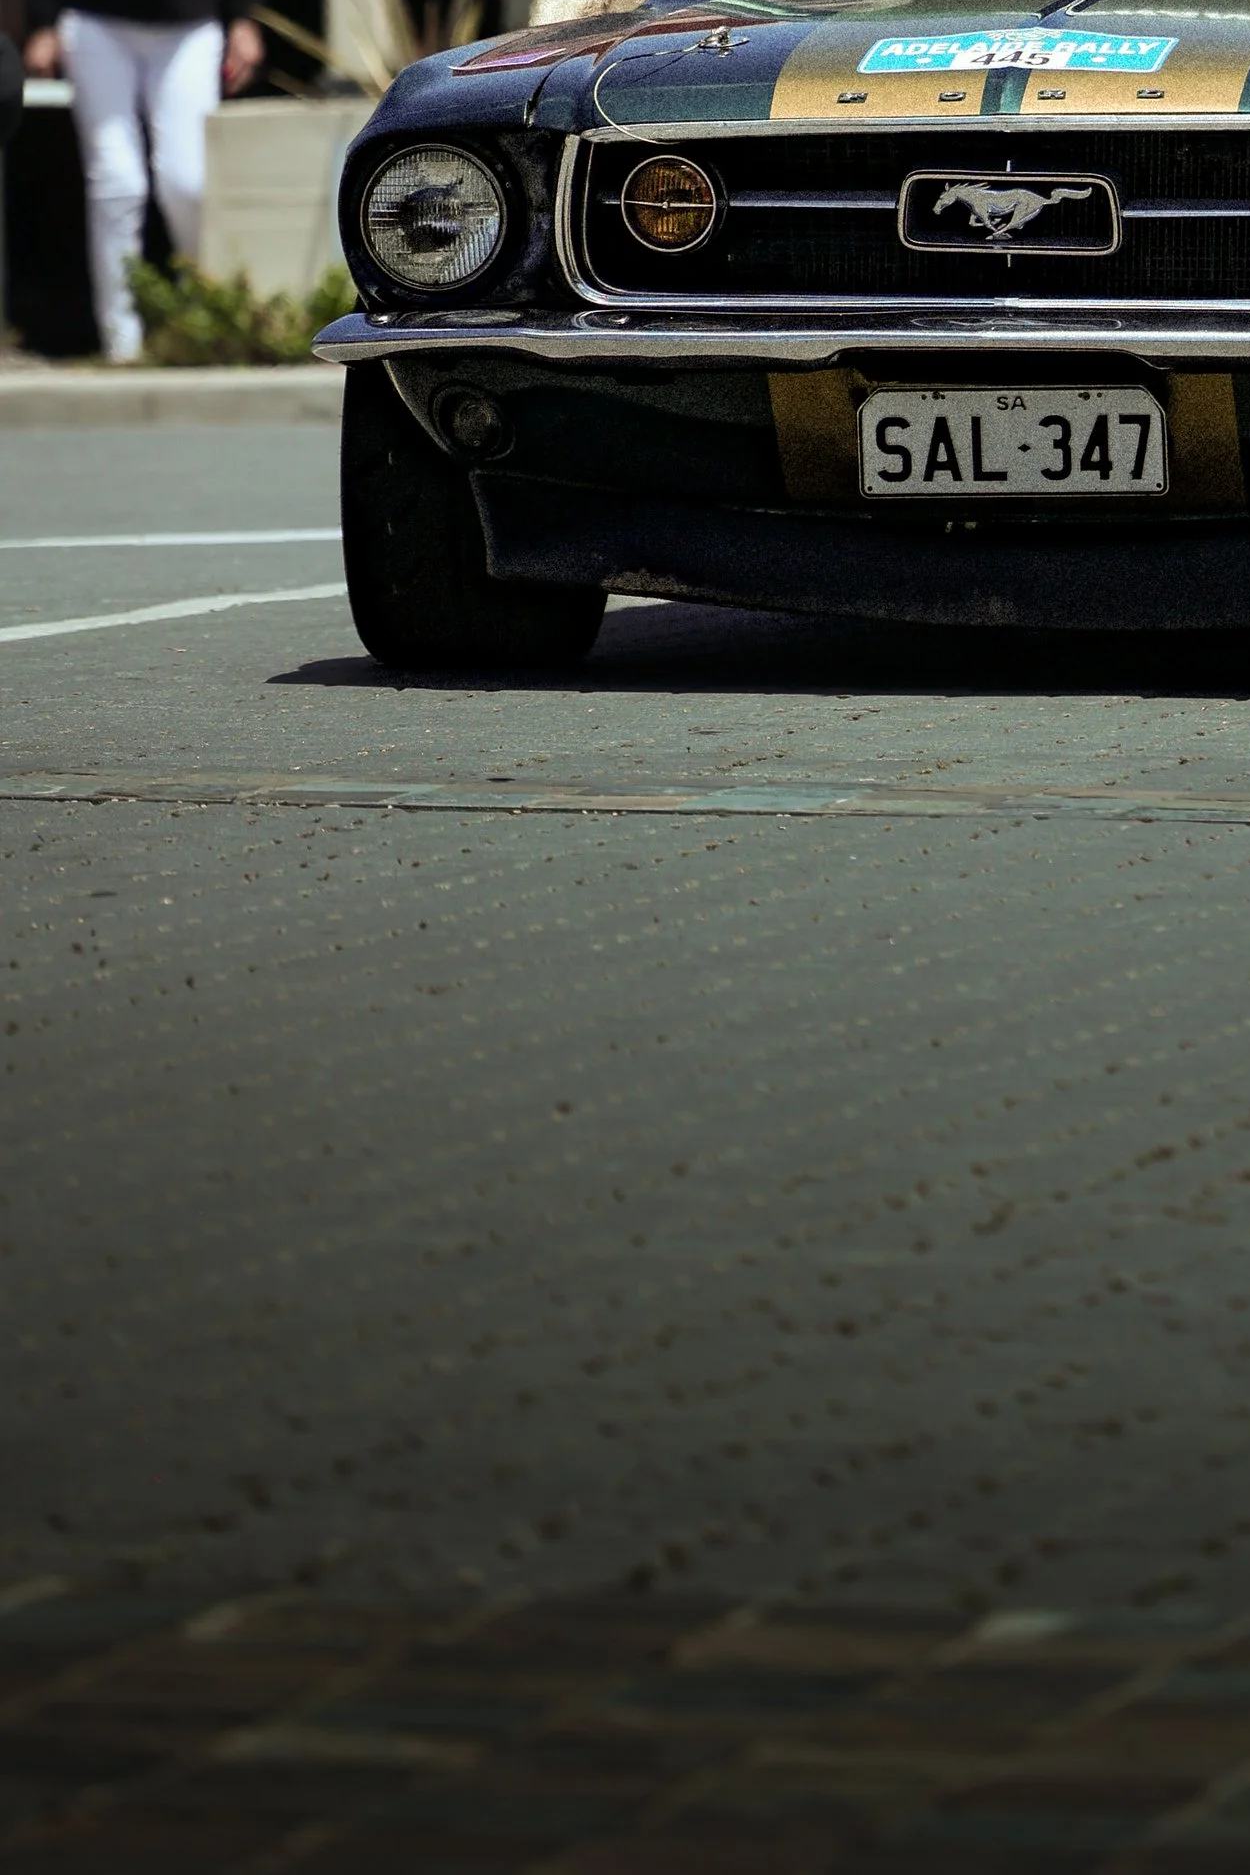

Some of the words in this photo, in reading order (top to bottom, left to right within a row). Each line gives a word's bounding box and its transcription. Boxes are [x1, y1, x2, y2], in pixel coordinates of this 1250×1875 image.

[880, 41, 1045, 56] ADELAIDE
[1052, 41, 1161, 55] RALLY
[970, 50, 1053, 67] 445
[996, 395, 1028, 412] SA
